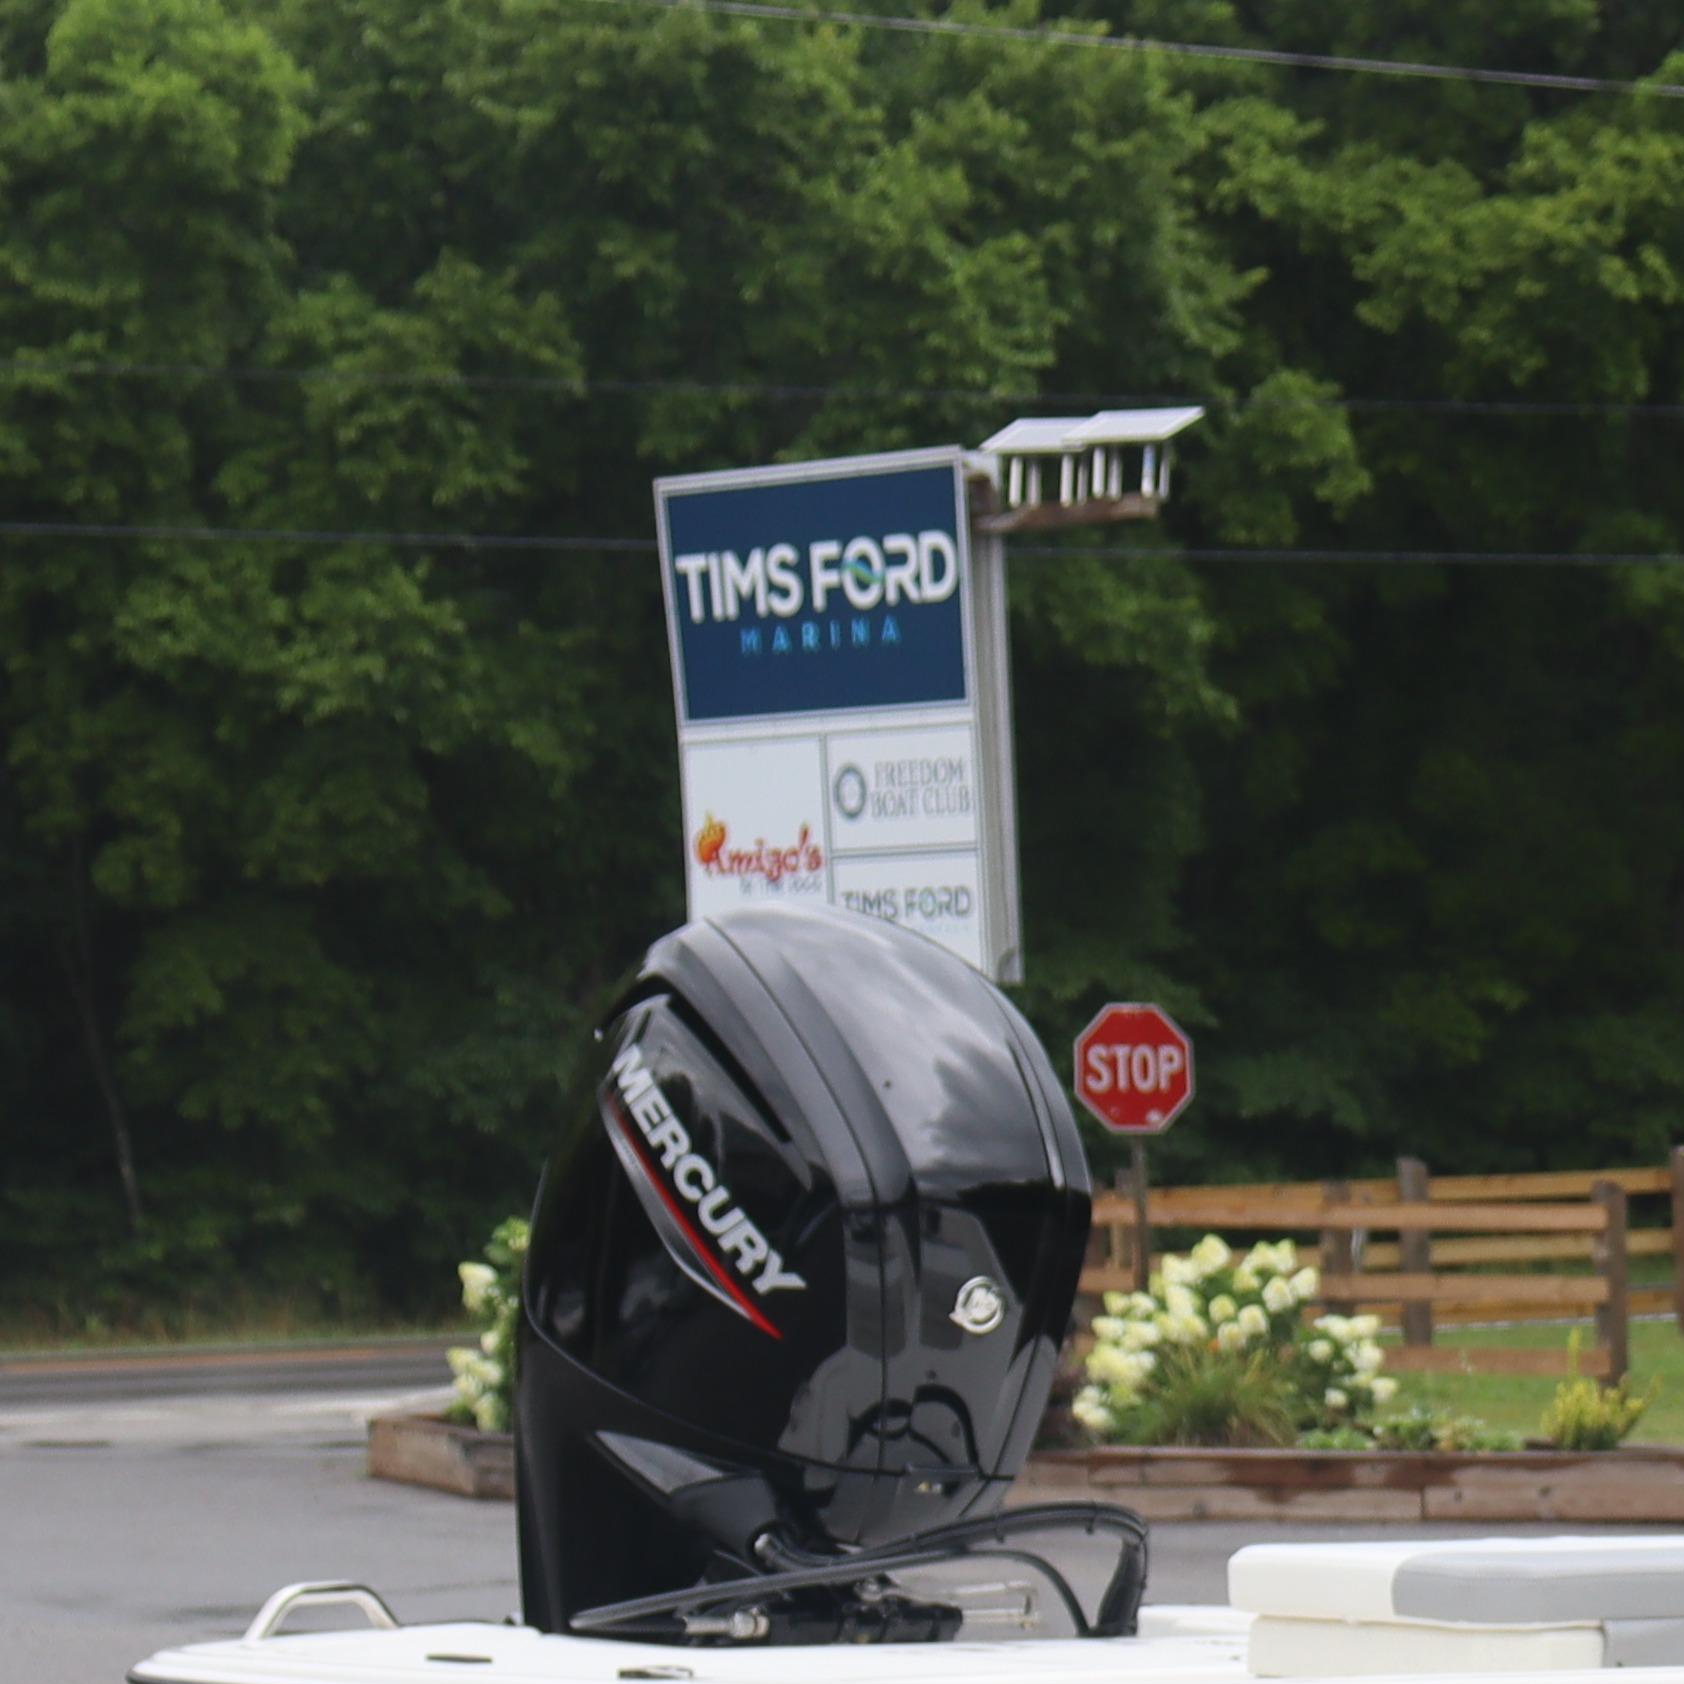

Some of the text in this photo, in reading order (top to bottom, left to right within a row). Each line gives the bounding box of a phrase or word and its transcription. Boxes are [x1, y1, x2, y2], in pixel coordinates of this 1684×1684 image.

[674, 529, 958, 623] TIMS FORD
[740, 616, 901, 655] MARINA
[874, 756, 963, 788] FREEDOM
[870, 784, 970, 817] BOAT CLUB
[694, 815, 823, 881] Amigo's
[842, 885, 970, 921] TIMS FORD
[1085, 1043, 1183, 1094] STOP
[612, 1044, 807, 1293] MERCURY
